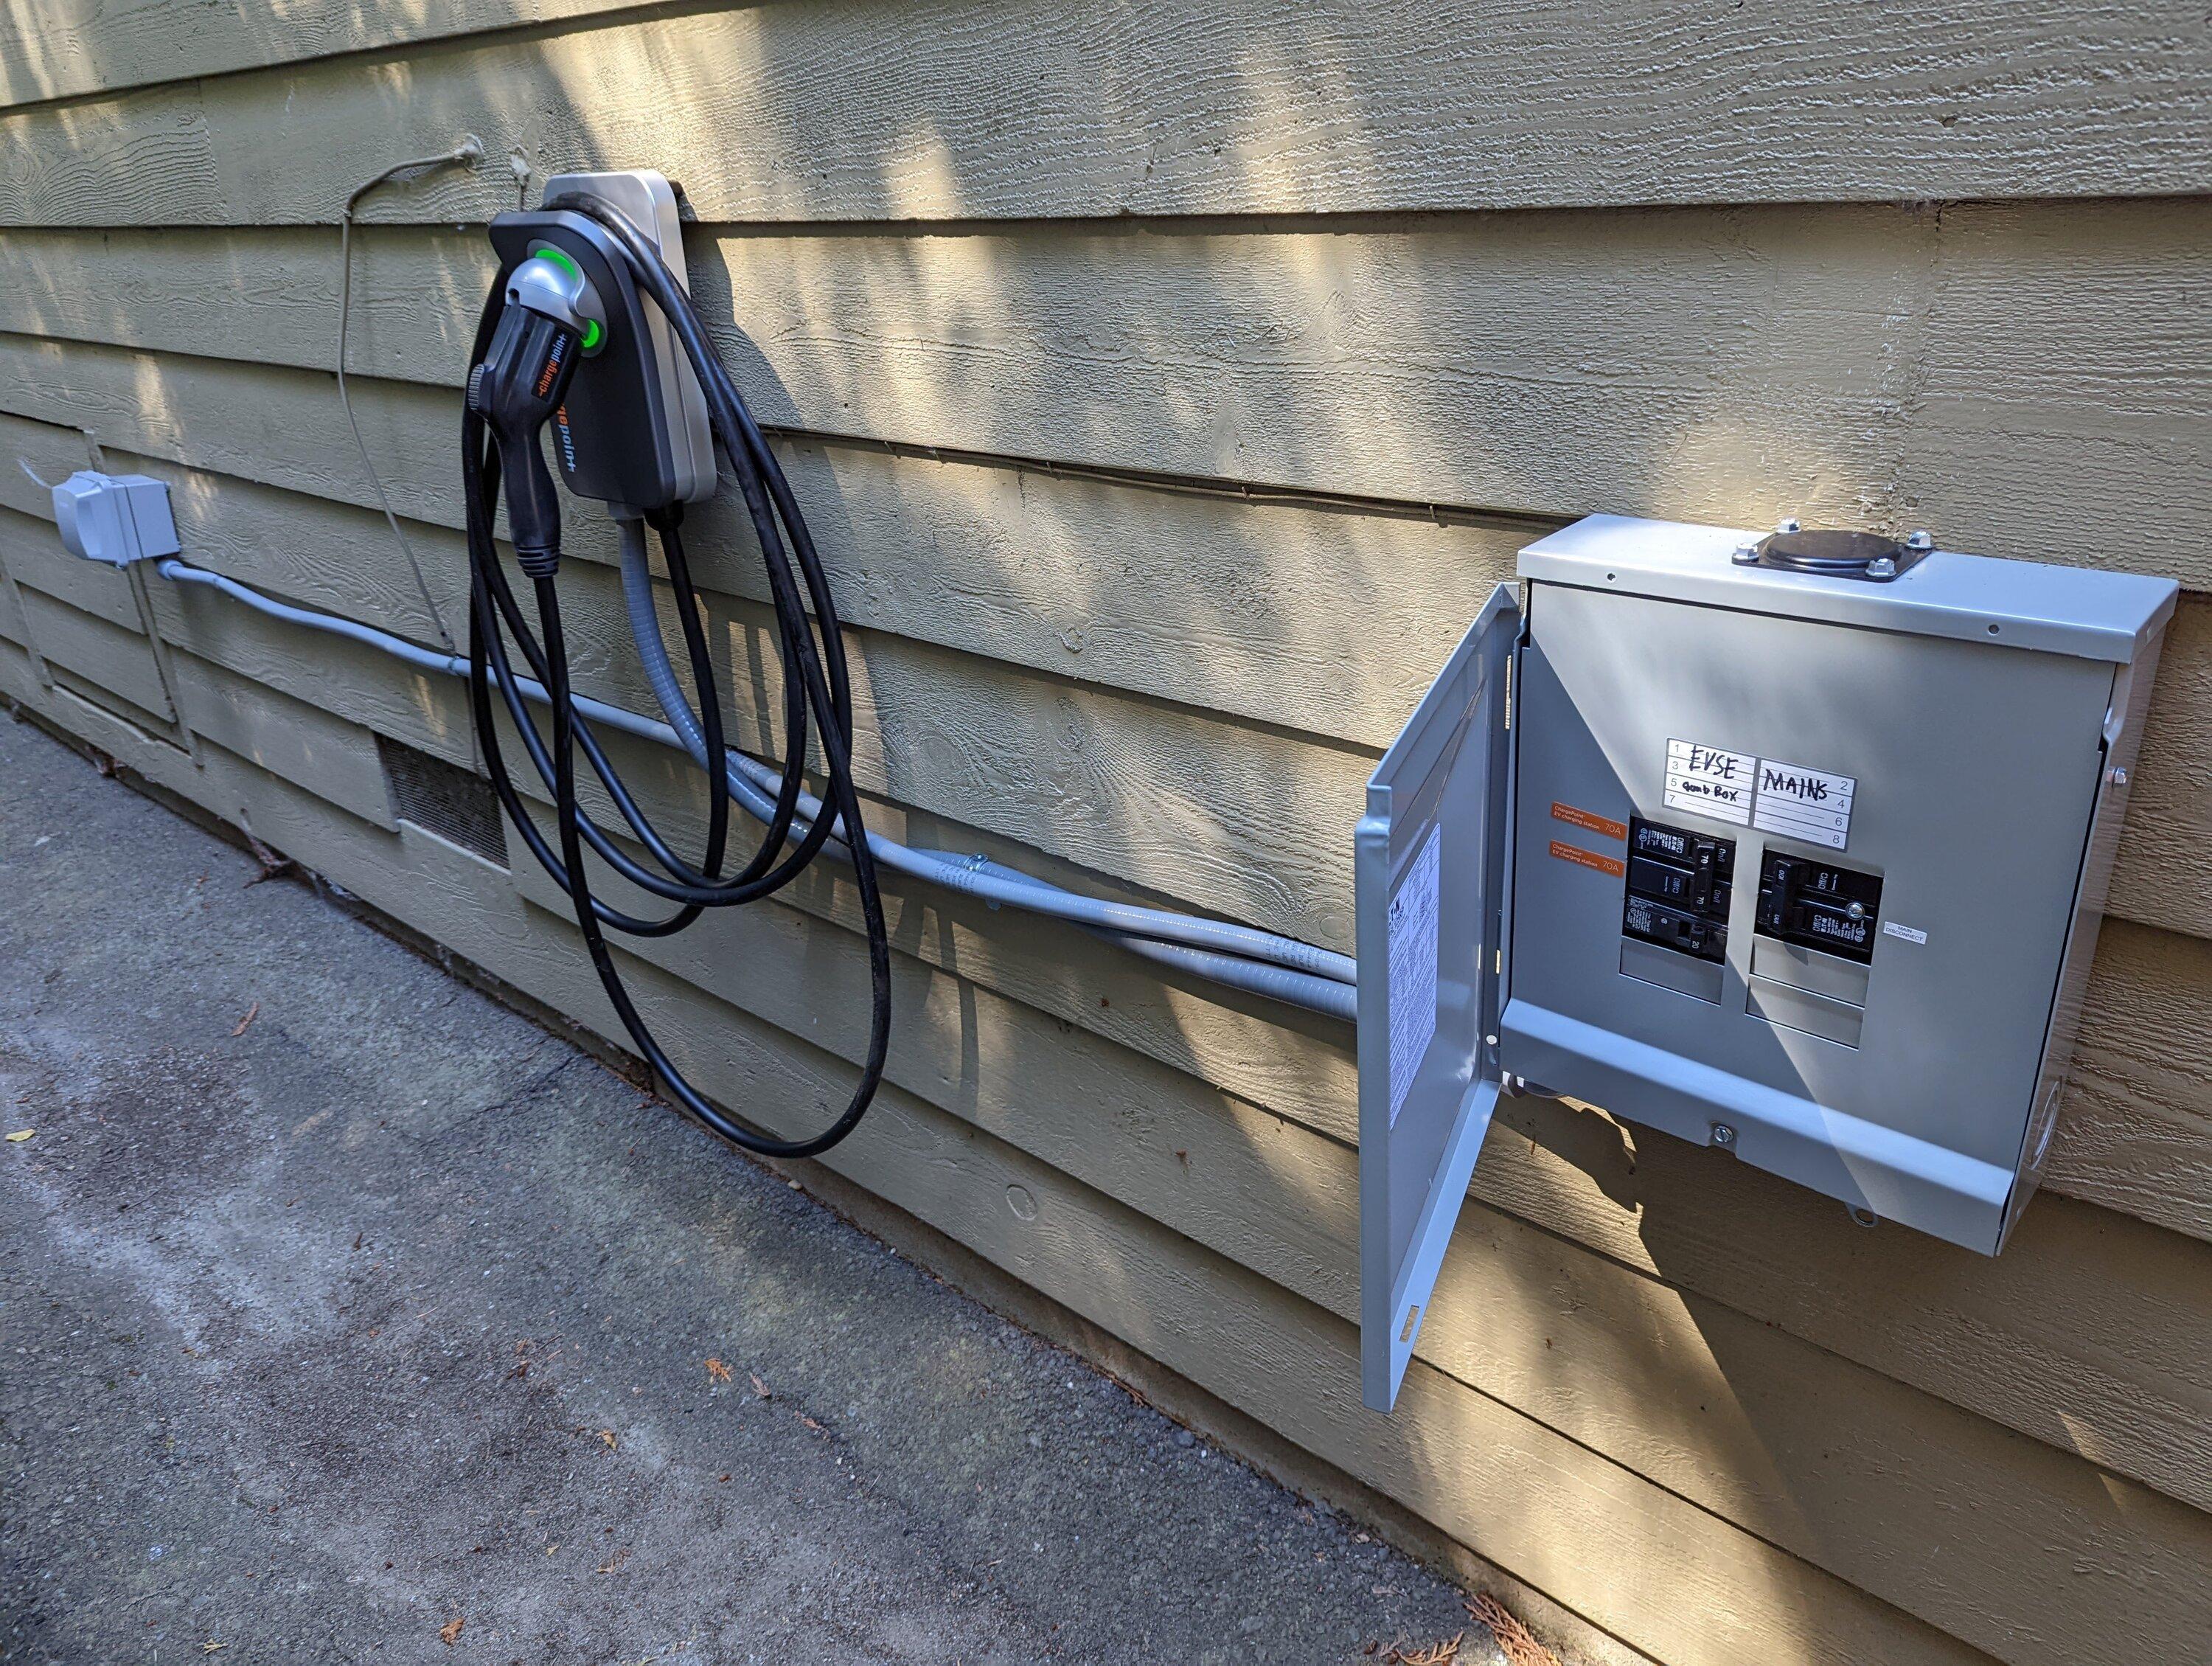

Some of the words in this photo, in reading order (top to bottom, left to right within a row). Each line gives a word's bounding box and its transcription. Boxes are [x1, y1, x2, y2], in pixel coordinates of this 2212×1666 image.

[1674, 744, 1680, 752] 1
[1672, 761, 1678, 769] 3
[1689, 745, 1738, 779] EVSE
[1671, 778, 1677, 786] 5
[1764, 769, 1827, 800] MAINS
[1840, 781, 1847, 791] 2
[1669, 795, 1676, 803] 7
[1837, 800, 1845, 808] 4
[1554, 805, 1585, 817] ChargePoint
[1561, 813, 1583, 826] charging
[1584, 819, 1600, 830] station
[1835, 817, 1842, 826] 6
[1604, 823, 1621, 835] 70A
[1832, 835, 1840, 844] 8
[1559, 851, 1581, 864] charging
[1582, 857, 1598, 867] station
[1700, 854, 1709, 864] 70
[1602, 860, 1618, 872] 70A
[1697, 896, 1705, 905] 70
[1885, 928, 1924, 941] DISCONNECT
[1691, 940, 1700, 949] 20
